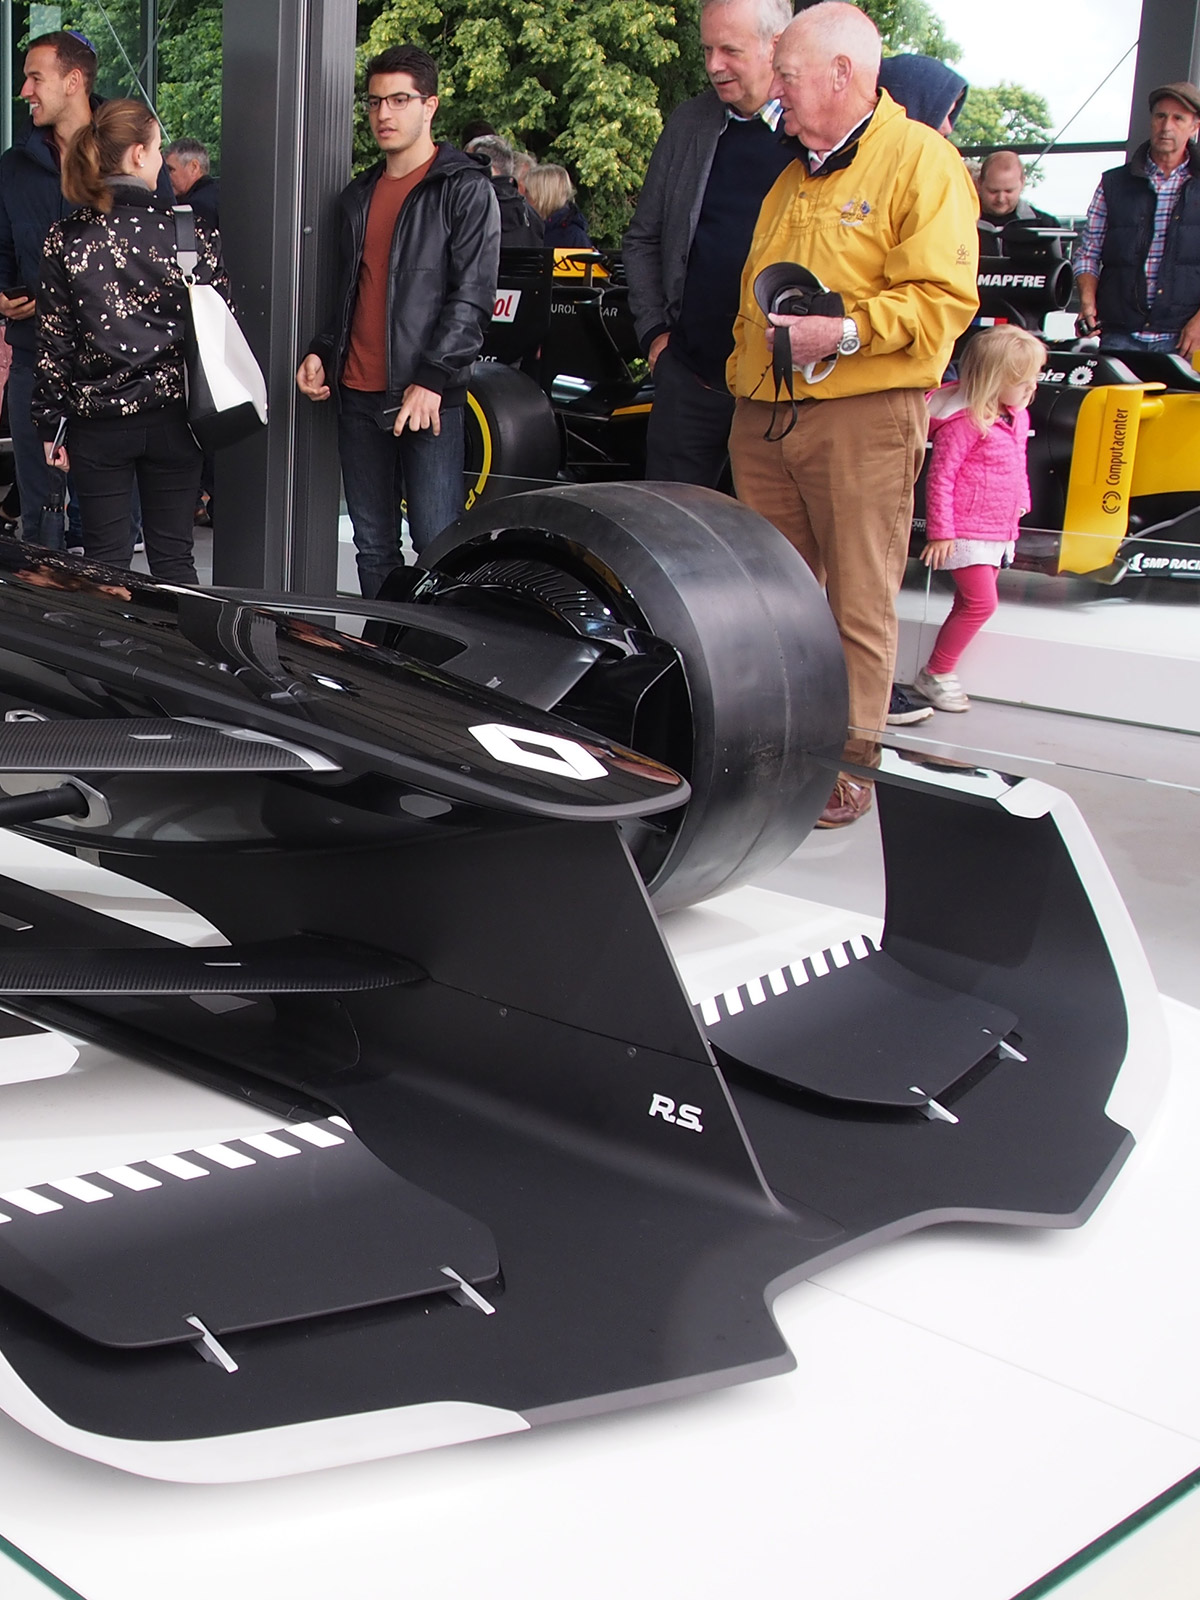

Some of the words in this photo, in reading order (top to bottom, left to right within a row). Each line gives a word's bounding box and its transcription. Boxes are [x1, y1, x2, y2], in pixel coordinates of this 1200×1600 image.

[977, 273, 1046, 288] MAPFRE
[492, 294, 513, 317] ol
[551, 303, 577, 315] UROL
[1086, 359, 1098, 368] bp
[1037, 368, 1066, 382] ate
[1106, 408, 1129, 486] Computacenter
[1142, 557, 1170, 569] SMP
[1169, 558, 1200, 570] RACI
